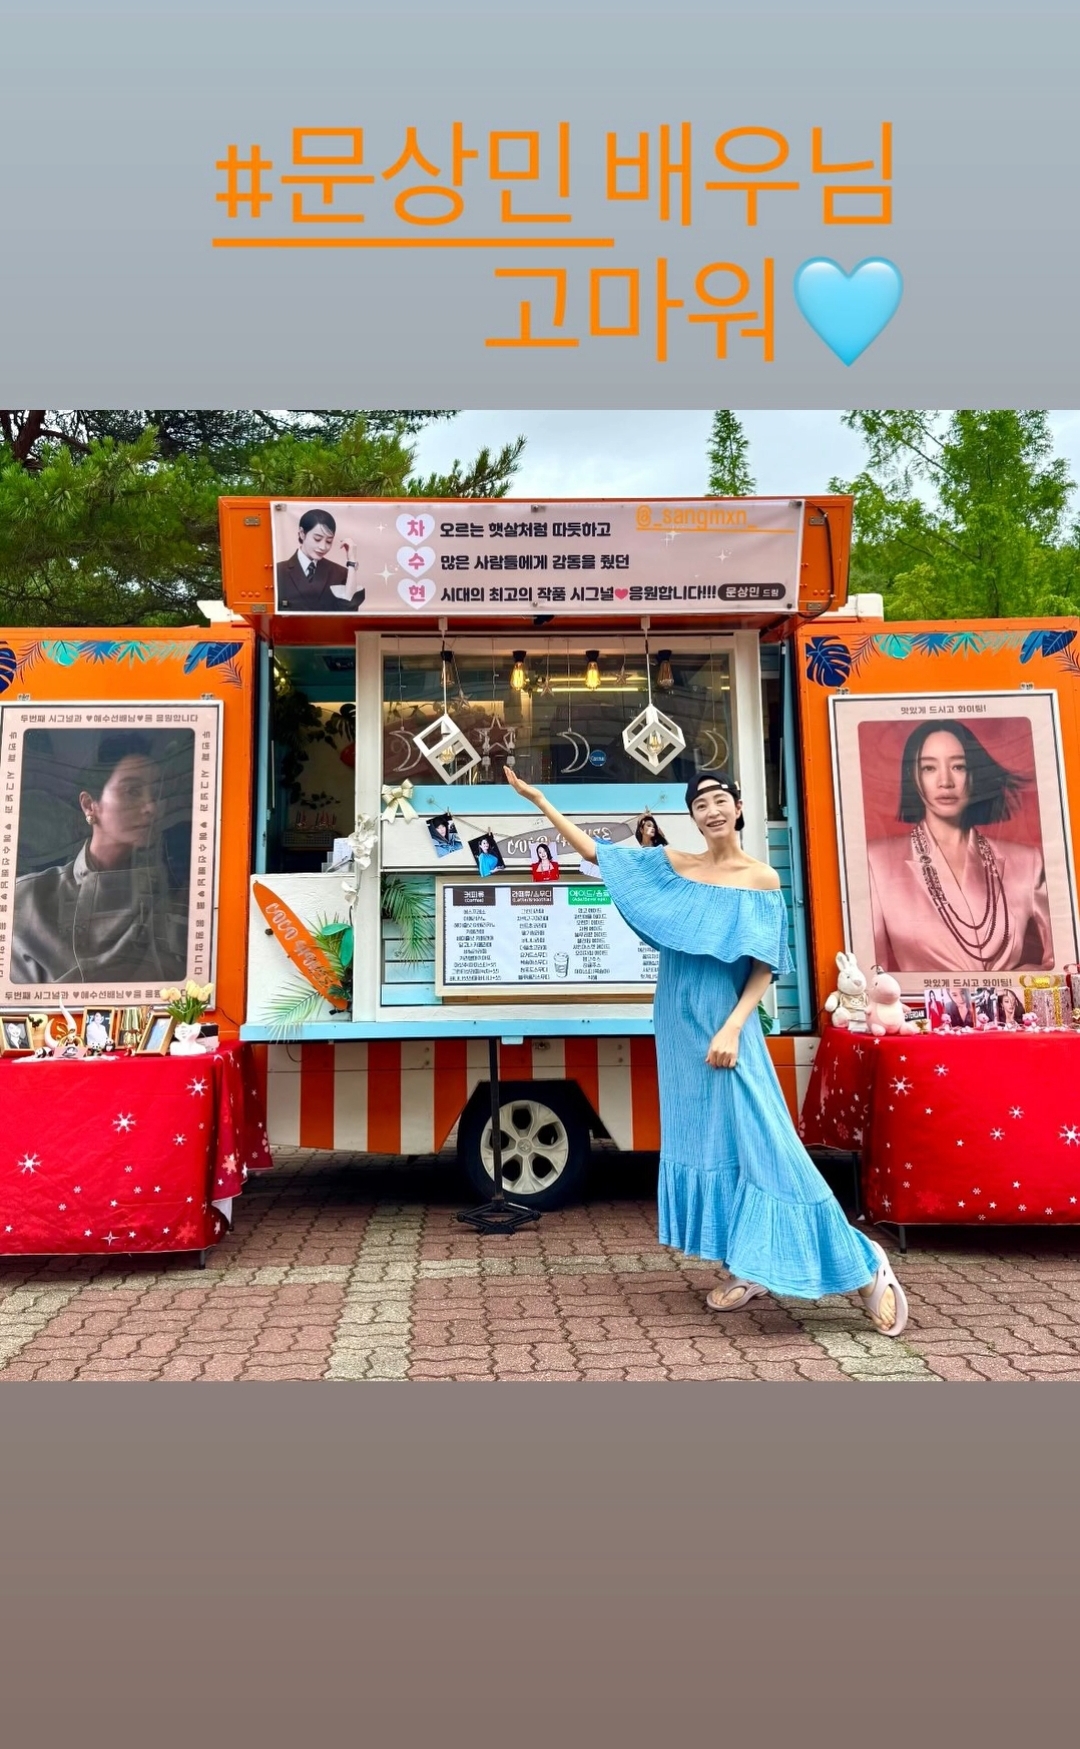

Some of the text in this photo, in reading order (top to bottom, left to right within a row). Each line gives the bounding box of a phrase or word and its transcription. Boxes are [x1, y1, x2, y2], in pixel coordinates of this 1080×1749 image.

[407, 518, 611, 537] 차 오르는 햇살처럼 따듯하고
[408, 553, 629, 570] 수 많은 사람들에게 감동을 줬던
[409, 585, 716, 602] 현 시대의 최고의 작품 시그널 응원합니다!!!
[726, 587, 779, 598] 문상민 드림
[21, 714, 45, 723] 두번째
[48, 714, 82, 723] 시그널과
[156, 714, 198, 722] 응원합니다
[900, 706, 926, 715] 맛있게
[929, 706, 954, 714] 드시고
[201, 731, 211, 762] 두번째
[199, 770, 210, 812] 시그널과
[194, 919, 205, 975] 응원합니다
[923, 979, 949, 987] 맛있게
[953, 979, 979, 987] 드시고
[5, 991, 31, 1000] 두번째
